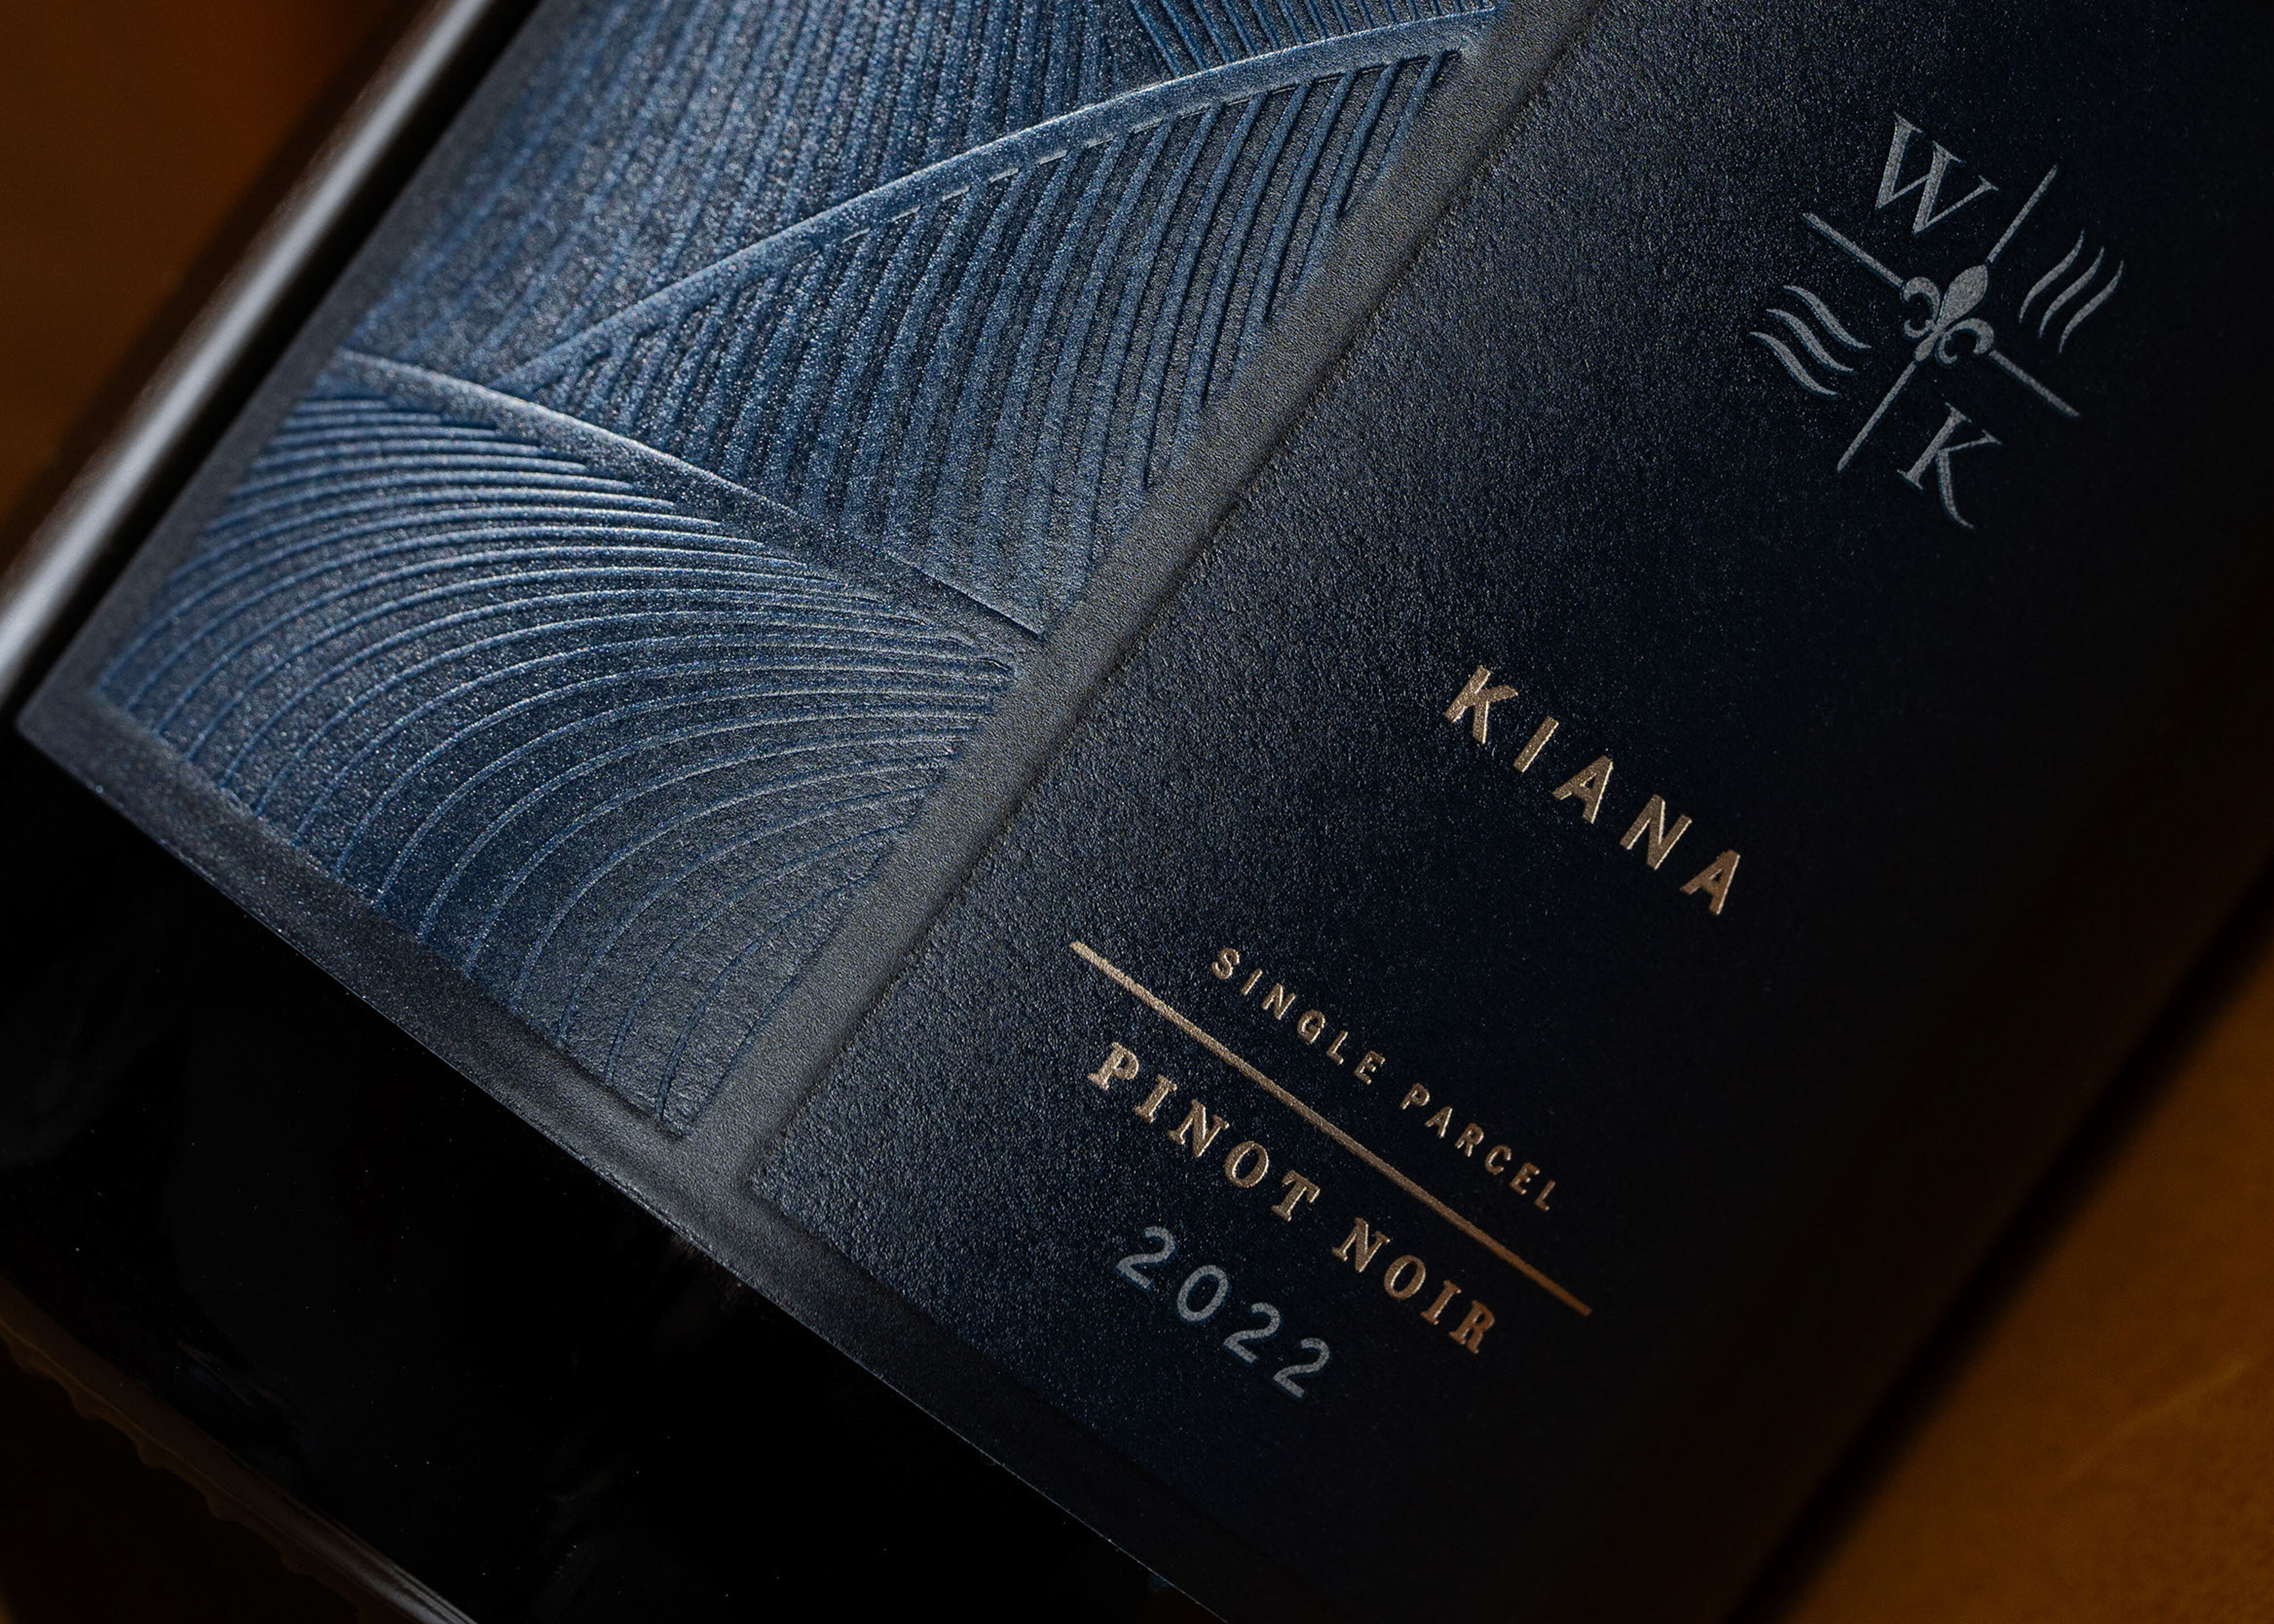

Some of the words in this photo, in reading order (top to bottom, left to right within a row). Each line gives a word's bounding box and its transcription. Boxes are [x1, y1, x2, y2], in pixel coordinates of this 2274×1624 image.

[1876, 113, 1999, 235] W
[1897, 401, 2003, 531] K
[1443, 664, 1741, 916] KIANA
[1210, 947, 1385, 1084] SINGLE
[1399, 1082, 1557, 1211] PARCEL
[1087, 1041, 1321, 1222] PINOT
[1331, 1216, 1496, 1355] NOIR
[1115, 1226, 1333, 1402] 2022
